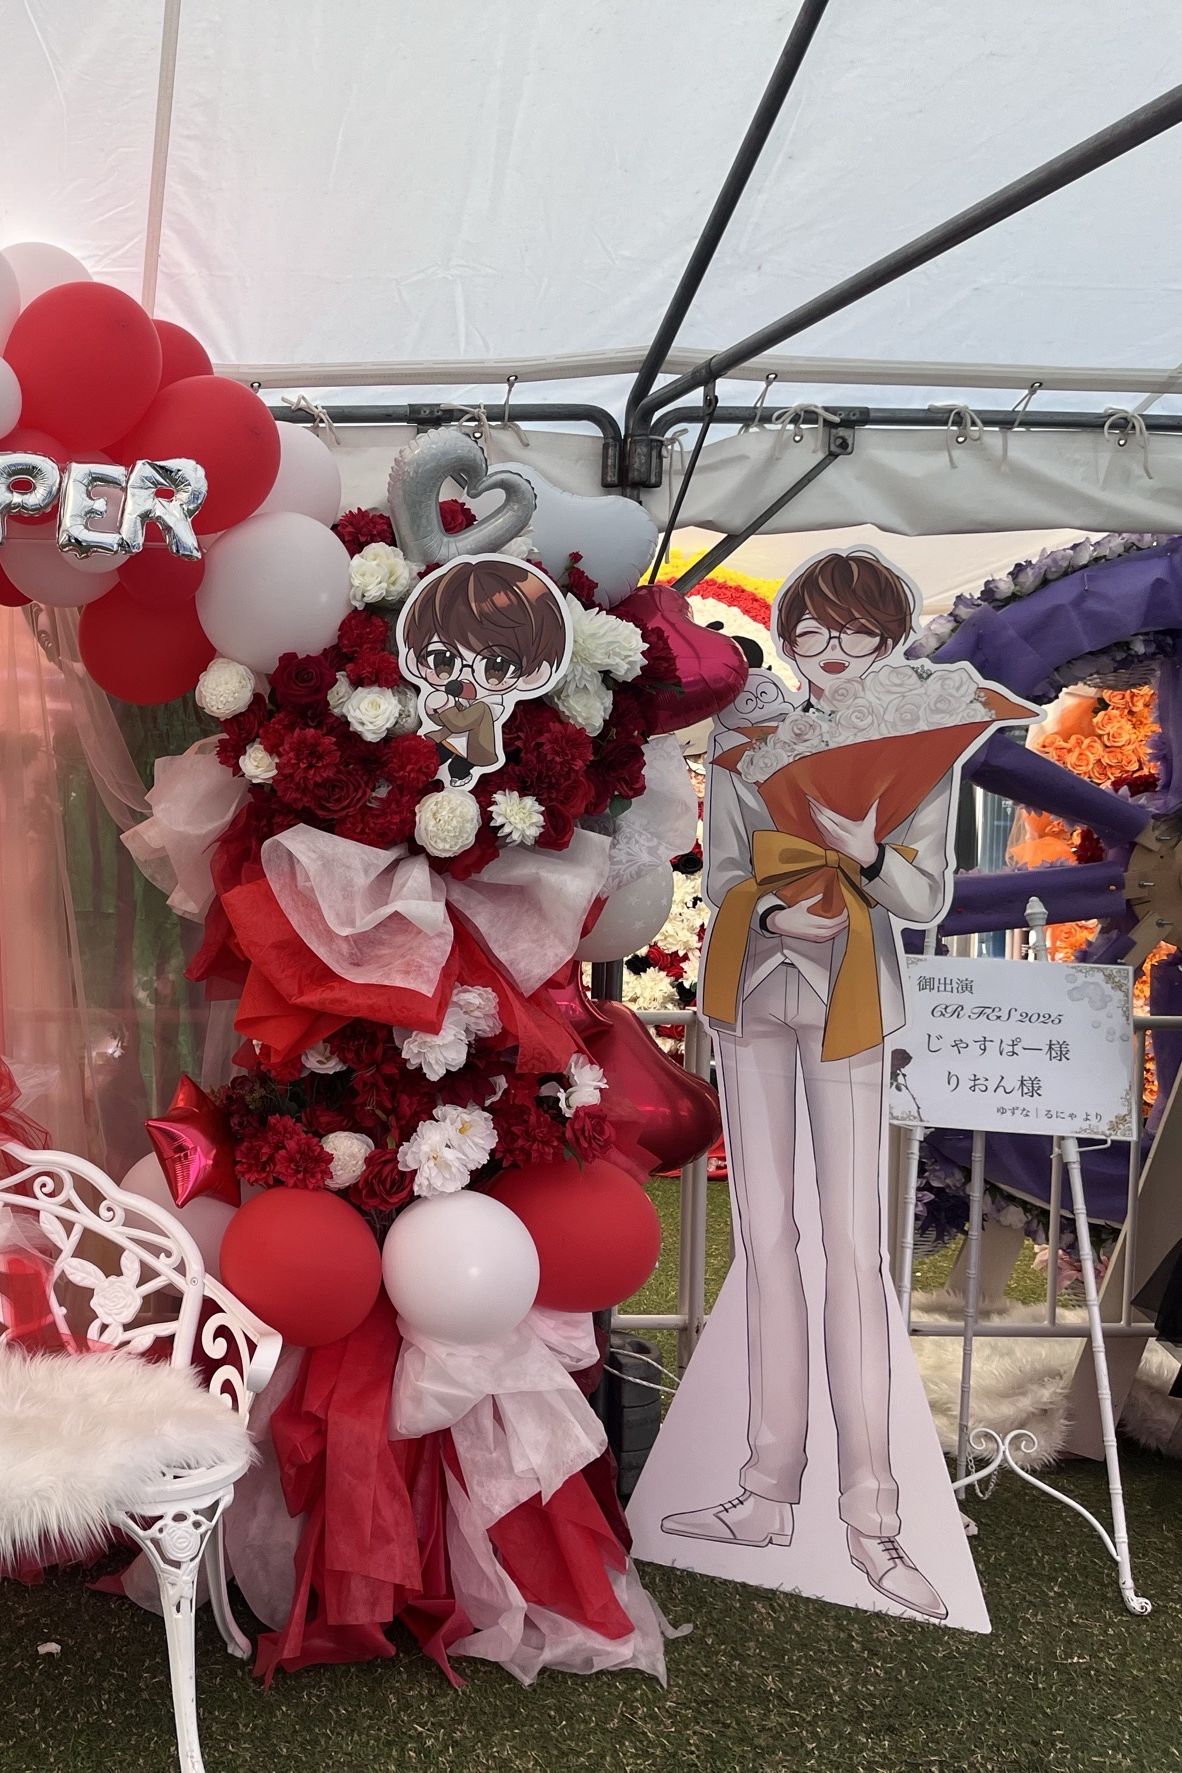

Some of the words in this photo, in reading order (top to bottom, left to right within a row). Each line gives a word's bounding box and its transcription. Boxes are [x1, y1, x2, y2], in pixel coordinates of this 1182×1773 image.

[917, 976, 974, 995] 御出演
[930, 1003, 966, 1020] CR
[968, 1006, 1018, 1022] FES
[1016, 1011, 1065, 1025] 2025
[926, 1032, 1071, 1062] じゃすぱー様
[947, 1071, 1043, 1098] りおん様
